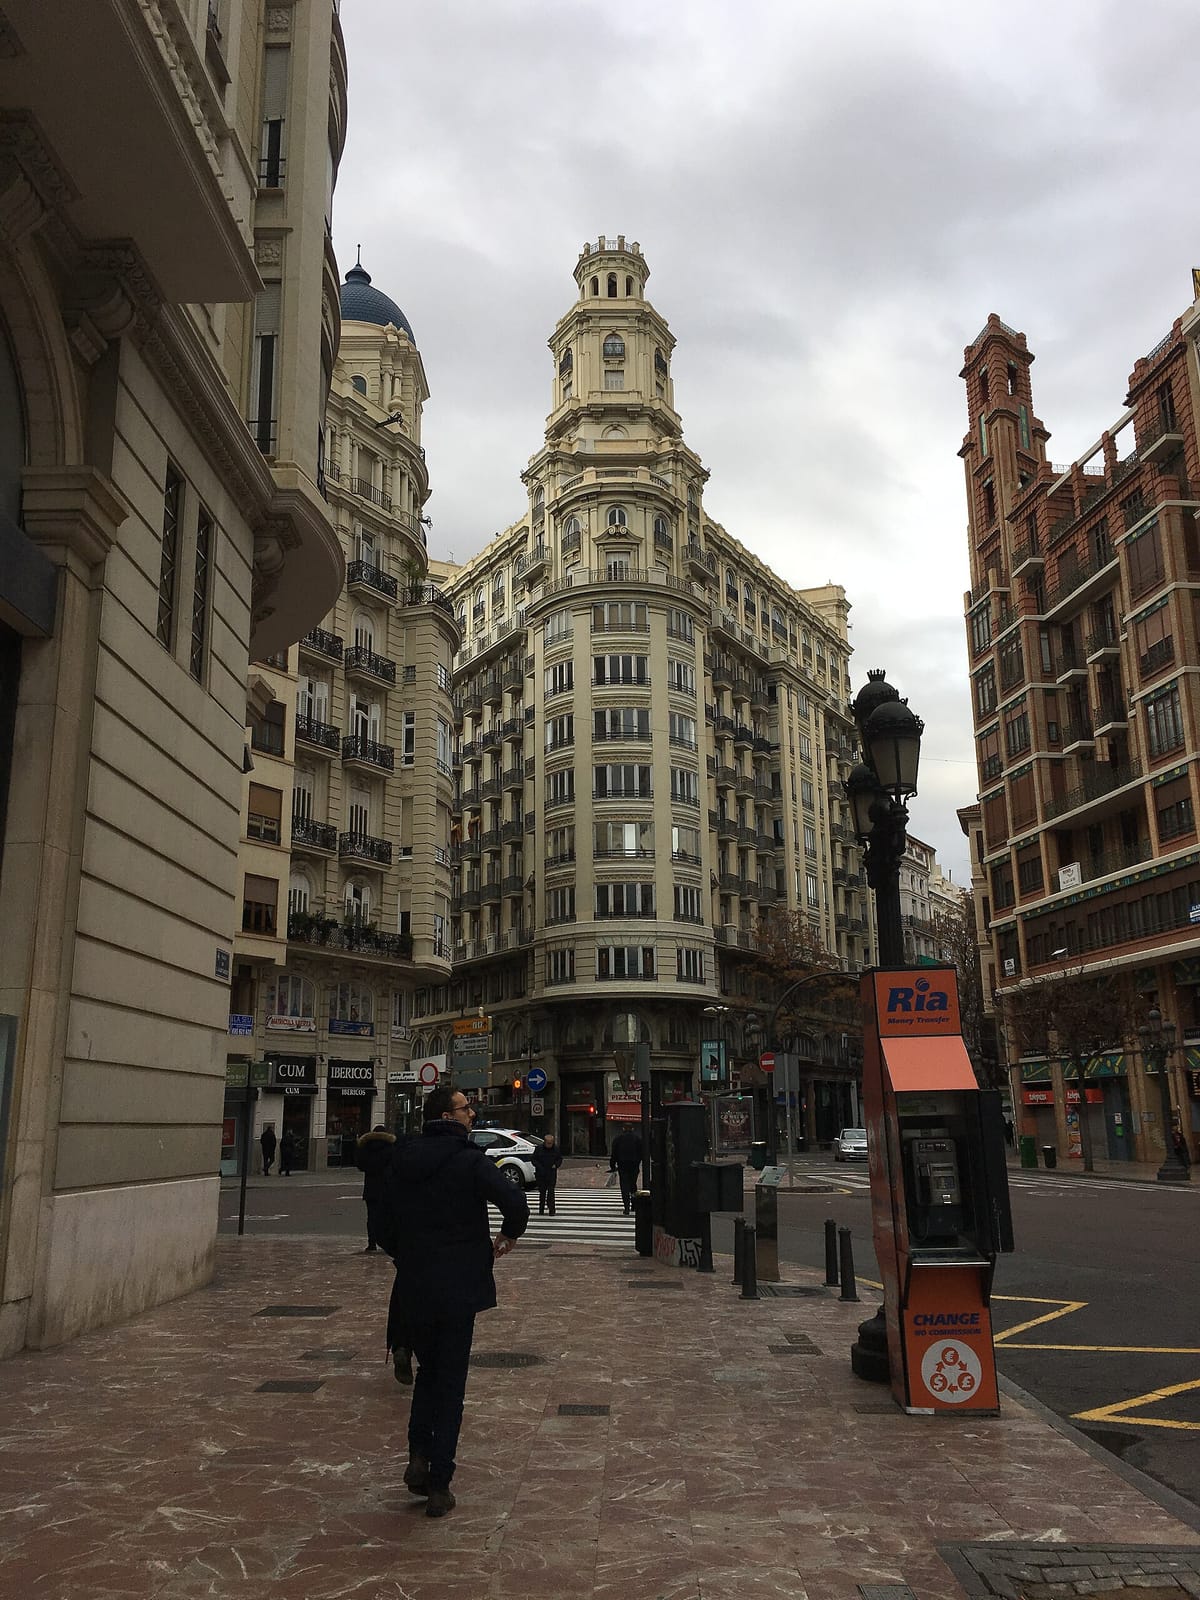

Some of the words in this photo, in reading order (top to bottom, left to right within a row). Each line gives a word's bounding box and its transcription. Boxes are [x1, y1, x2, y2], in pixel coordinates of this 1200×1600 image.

[887, 977, 948, 1012] Ria
[888, 1017, 915, 1025] Money
[917, 1016, 950, 1024] Transfer
[278, 1064, 305, 1077] CUM
[331, 1066, 373, 1080] IBERICOS
[285, 1087, 300, 1095] CUM
[341, 1088, 366, 1096] IBERICOS
[913, 1312, 980, 1326] CHANGE
[929, 1328, 981, 1336] COMMISSION
